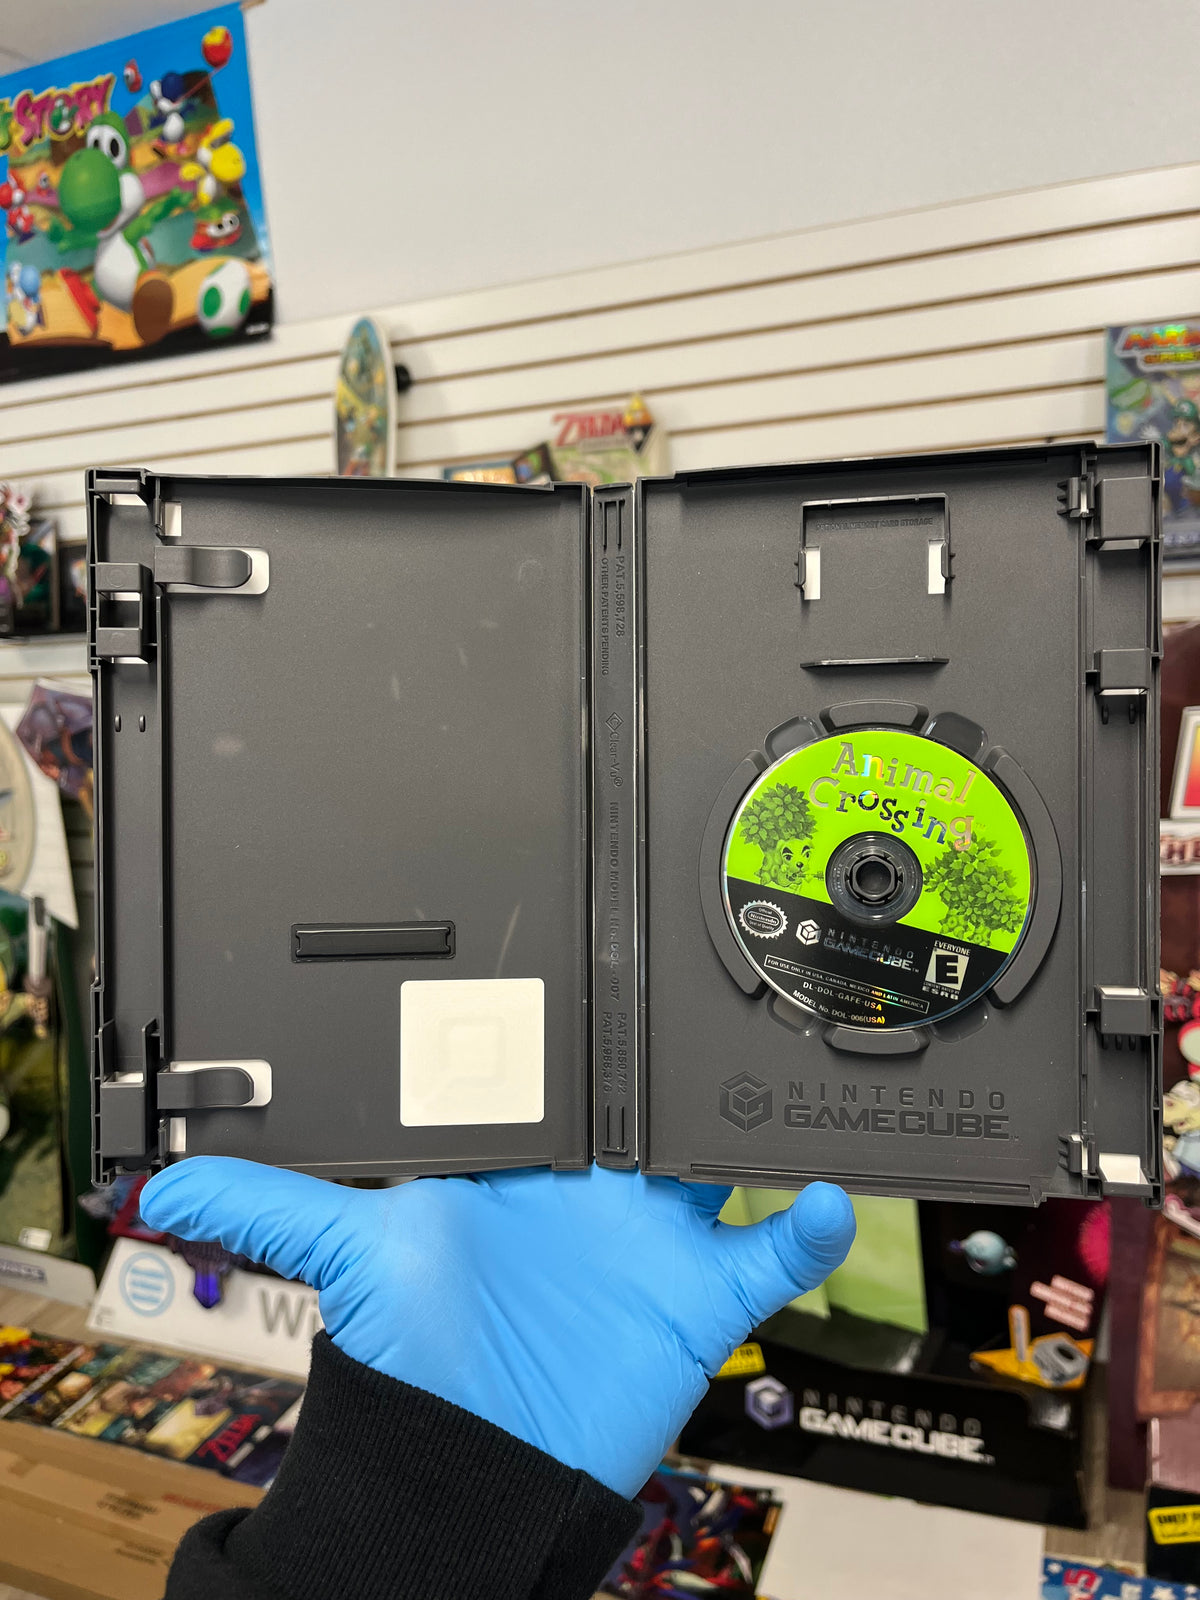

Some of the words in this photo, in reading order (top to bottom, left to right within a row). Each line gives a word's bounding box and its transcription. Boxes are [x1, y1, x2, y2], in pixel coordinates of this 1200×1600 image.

[601, 557, 609, 590] OTHER
[601, 592, 609, 634] PATENTS
[601, 636, 610, 677] PENDING
[831, 742, 977, 805] Animal
[808, 776, 975, 851] Crossing
[610, 801, 619, 868] NINTENDO
[750, 913, 777, 924] Nintendo
[823, 937, 914, 971] GAMECUBE
[828, 928, 914, 959] NINTENDO
[934, 940, 971, 956] EVERYONE
[767, 959, 779, 967] FOR
[780, 962, 790, 970] USE
[791, 965, 804, 974] ONLY
[871, 989, 883, 997] AND
[883, 993, 899, 1002] LATIN
[900, 998, 924, 1009] AMERICA
[936, 955, 958, 984] E
[792, 989, 817, 1008] MODEL
[802, 981, 883, 1011] DL-DOL-GAFE-USA
[788, 1081, 1006, 1111] NINTENDO
[784, 1104, 1010, 1141] GAMECUBE
[803, 1388, 982, 1437] NINTENDO
[800, 1406, 985, 1464] GAMECUBE
